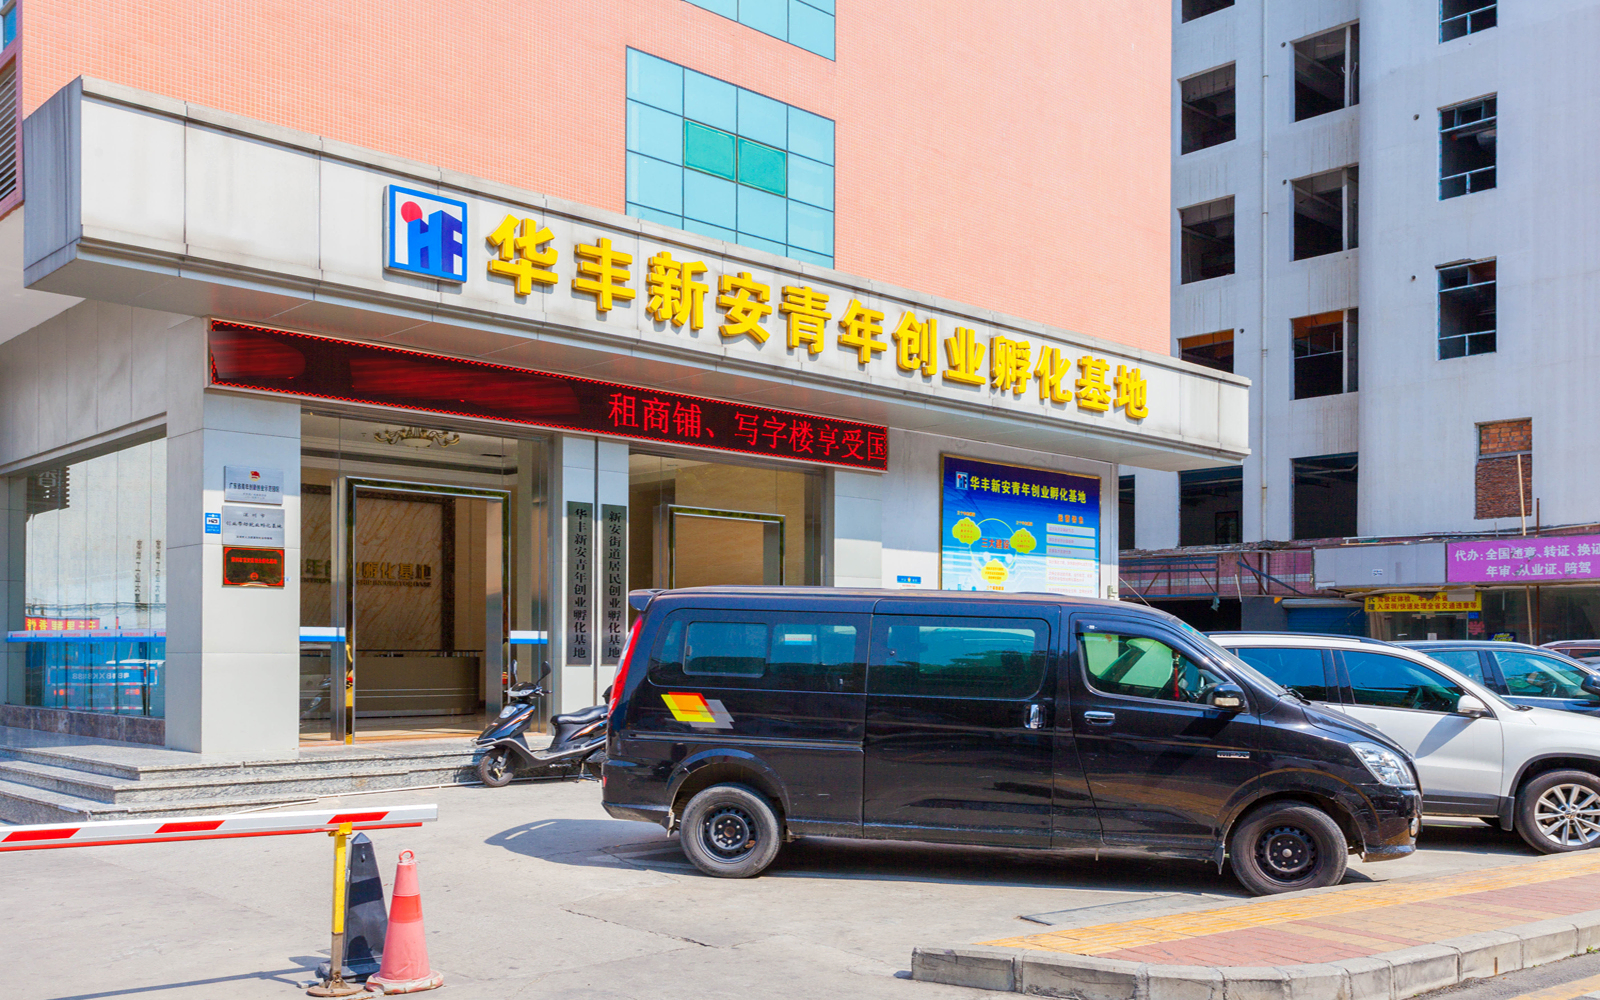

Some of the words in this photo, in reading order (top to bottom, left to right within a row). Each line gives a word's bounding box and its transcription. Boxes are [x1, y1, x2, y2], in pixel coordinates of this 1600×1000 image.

[486, 214, 1148, 419] 华丰新安青年创业孵化基地
[608, 392, 885, 461] 租商铺、写字楼享受国
[970, 476, 1086, 504] 华丰新安青年创业孵化基地
[356, 562, 432, 580] 孵化基地
[981, 538, 1010, 550] 三大建设
[573, 508, 587, 658] 华丰新安青年创业孵化基地
[608, 511, 621, 658] 新安街道居民创业孵化基地
